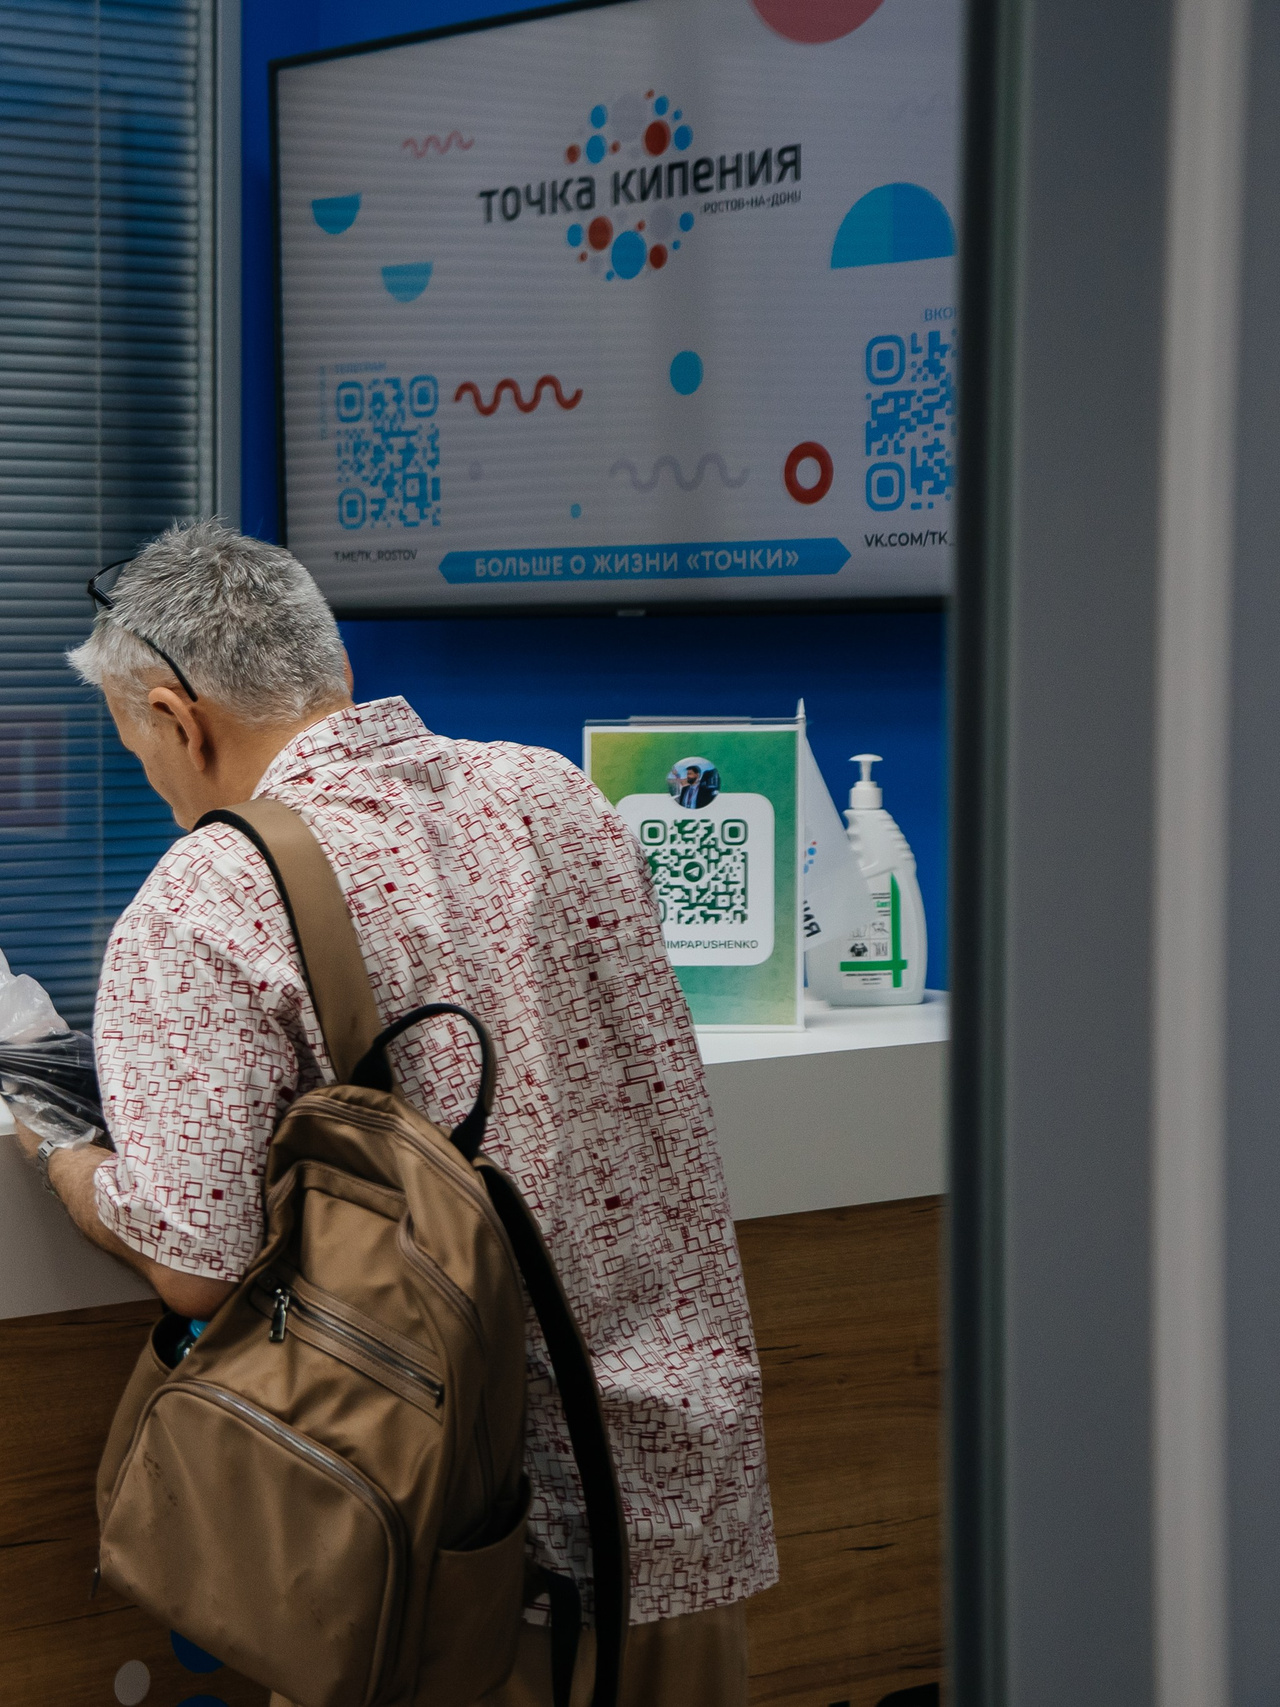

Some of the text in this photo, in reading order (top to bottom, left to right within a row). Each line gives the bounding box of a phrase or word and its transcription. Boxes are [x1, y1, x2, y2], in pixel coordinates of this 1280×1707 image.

[475, 548, 800, 577] БОЛЬШЕ О ЖИЗНИ «ТОЧКИ»
